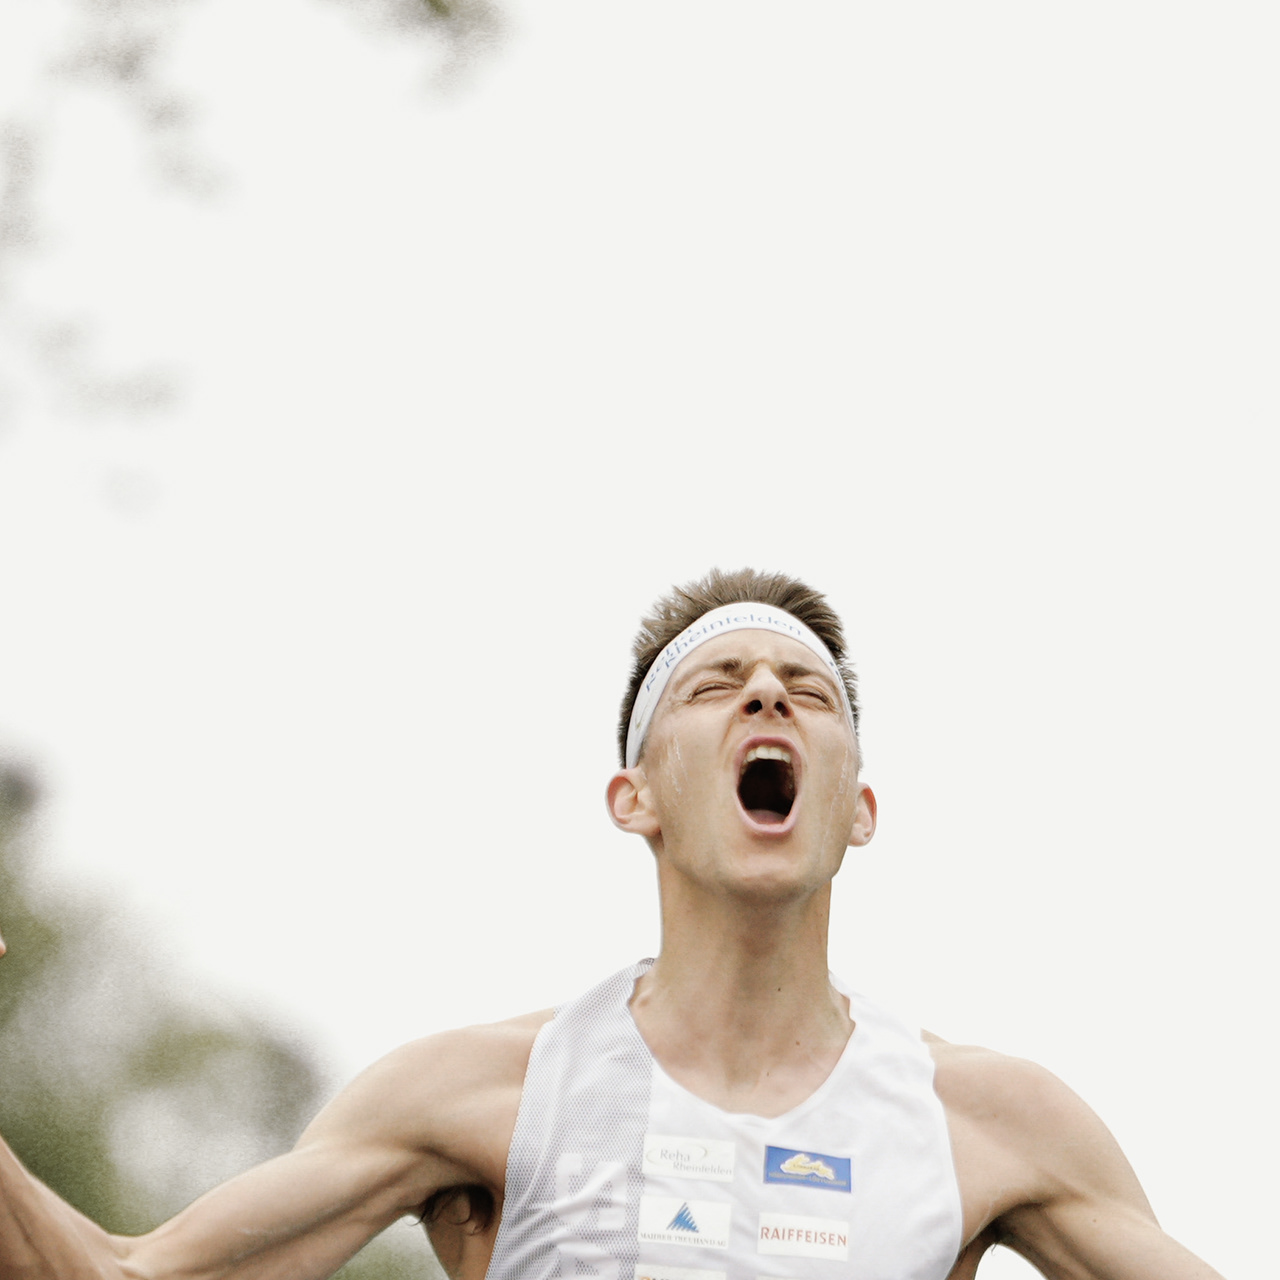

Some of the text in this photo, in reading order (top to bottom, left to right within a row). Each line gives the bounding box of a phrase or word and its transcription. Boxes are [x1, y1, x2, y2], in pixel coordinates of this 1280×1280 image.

[664, 614, 802, 669] Rheinfelden
[660, 1148, 691, 1162] Reha
[673, 1161, 733, 1176] Rheinfelden
[760, 1226, 848, 1247] RAIFFEISEN
